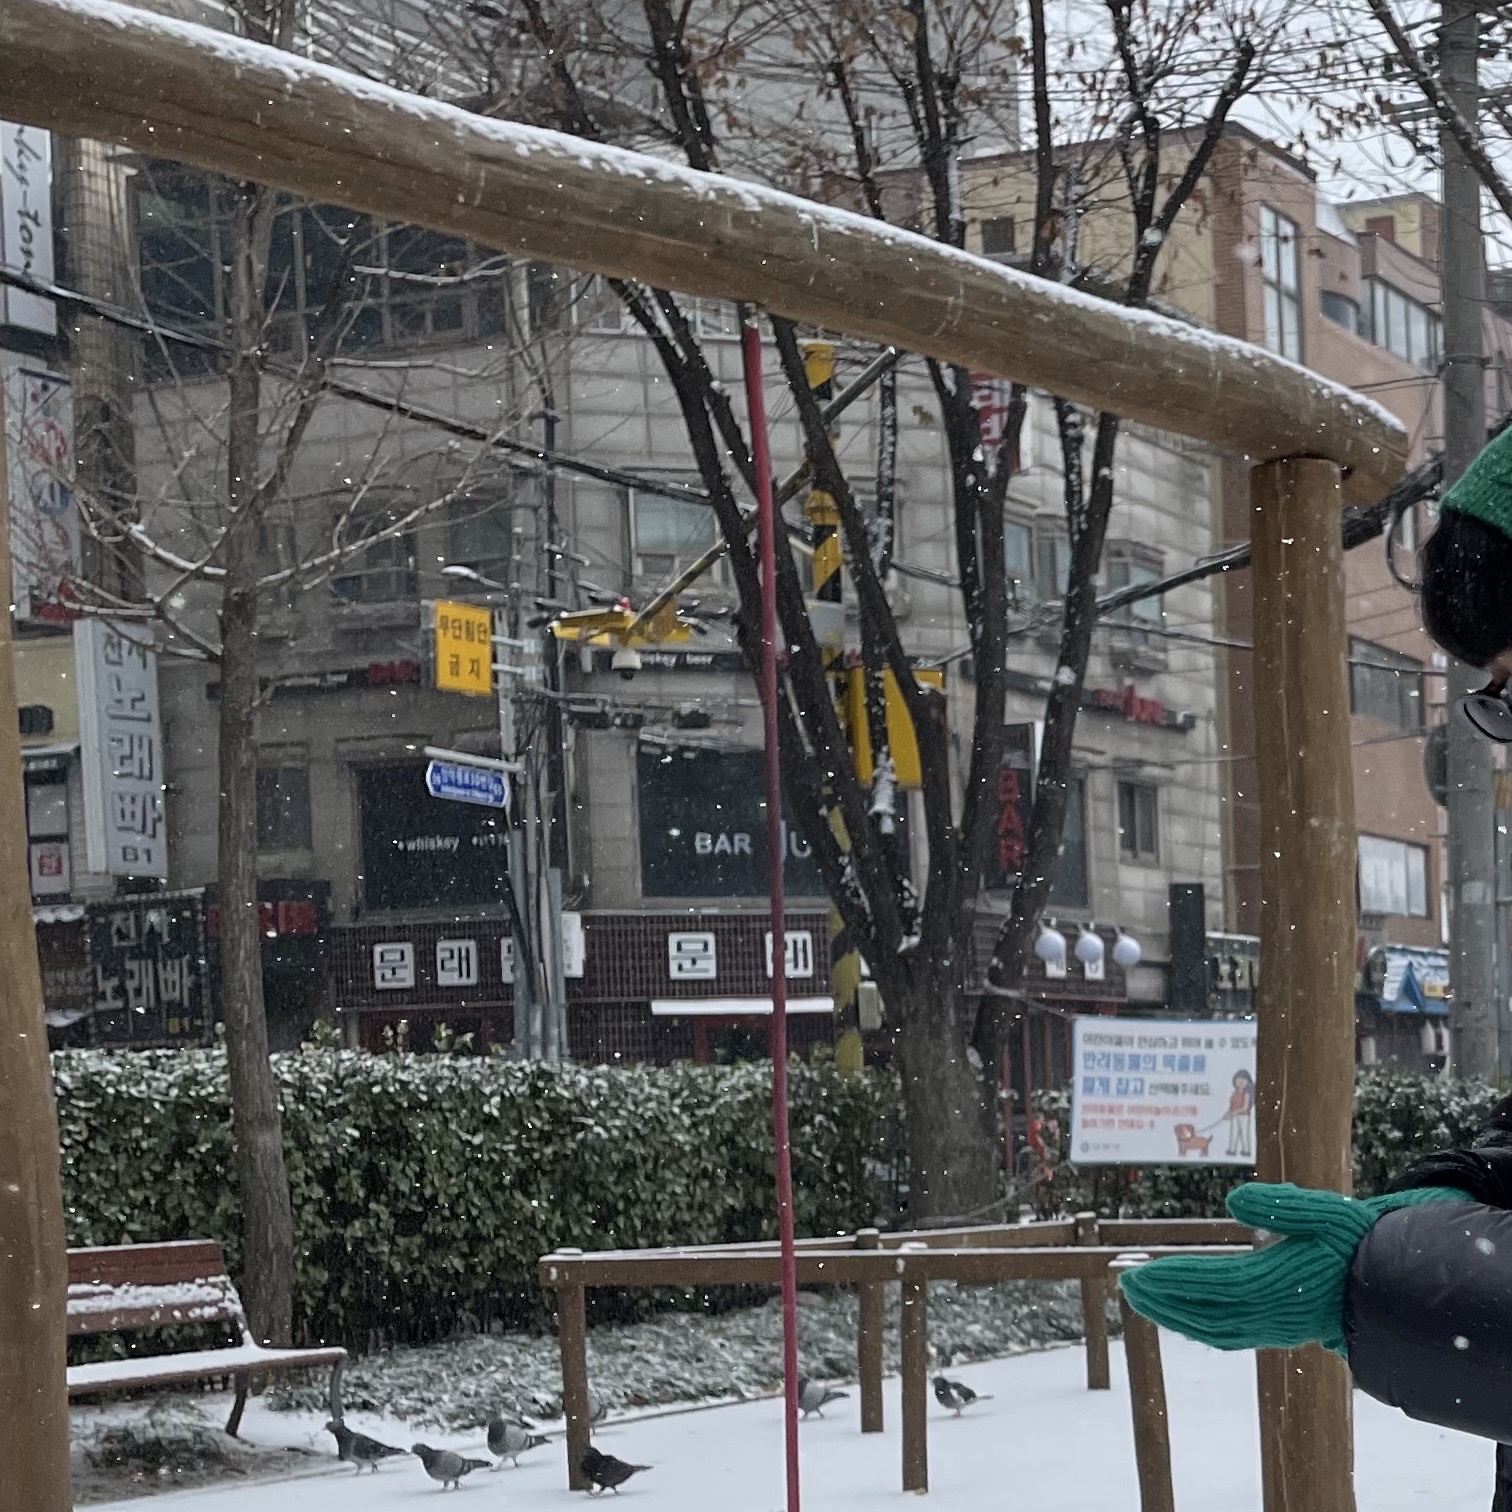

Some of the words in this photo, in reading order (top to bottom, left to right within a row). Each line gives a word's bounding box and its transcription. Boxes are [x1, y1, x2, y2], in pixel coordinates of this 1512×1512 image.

[439, 614, 489, 647] 무단횡단
[449, 653, 481, 681] 금지
[121, 845, 152, 864] B1
[694, 831, 752, 855] BAR
